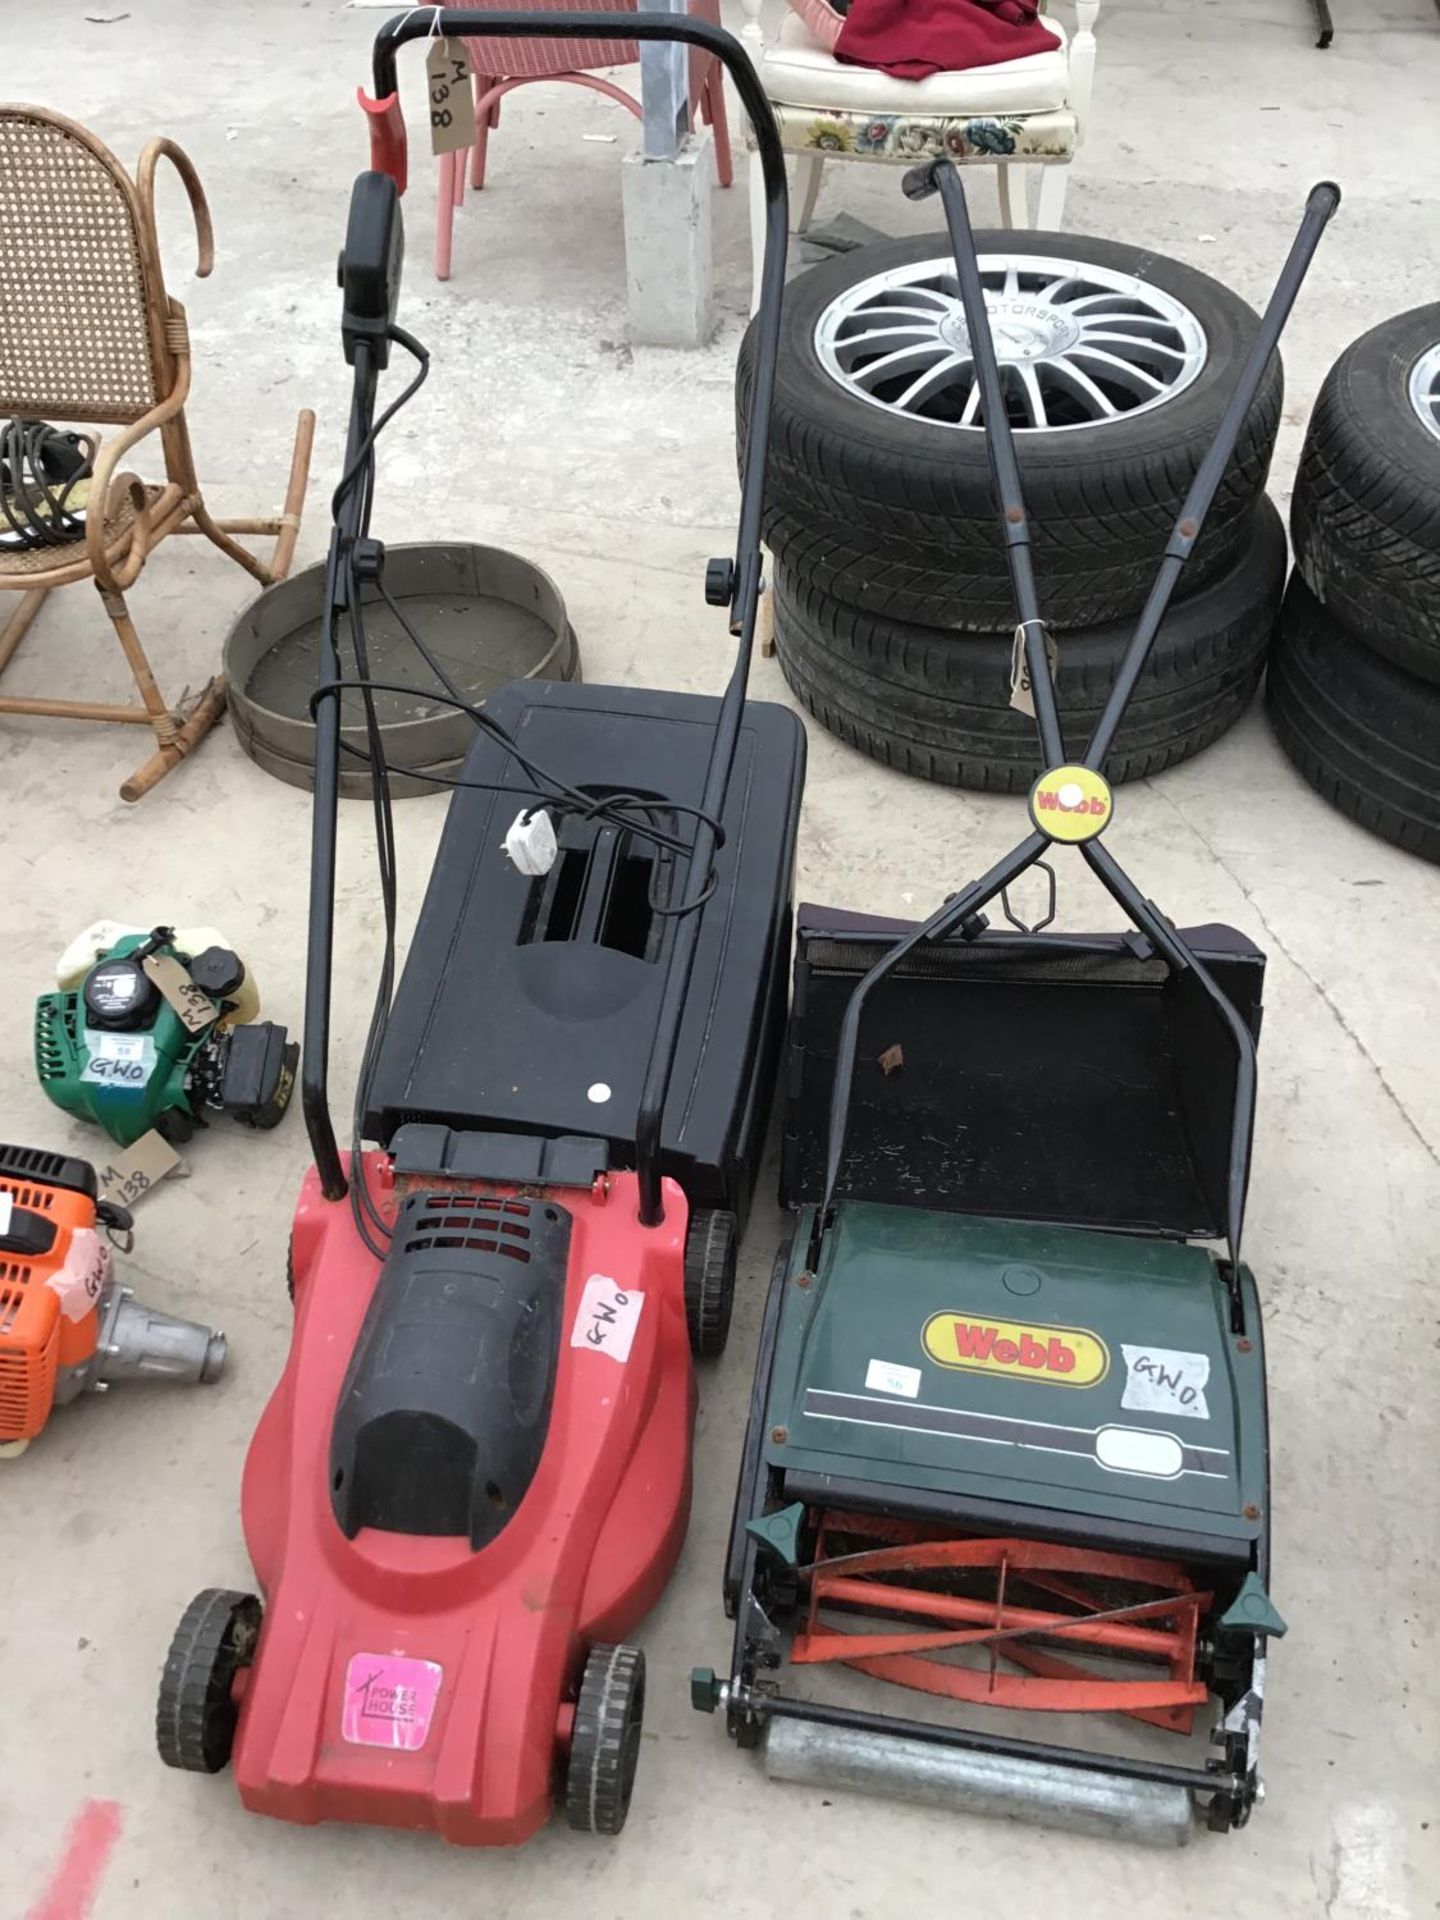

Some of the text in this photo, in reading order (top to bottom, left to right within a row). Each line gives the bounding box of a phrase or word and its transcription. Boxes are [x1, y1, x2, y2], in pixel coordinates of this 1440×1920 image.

[451, 60, 468, 84] M
[431, 73, 453, 128] 138
[179, 984, 212, 1013] 138
[181, 1008, 203, 1026] M
[100, 1165, 125, 1187] M
[116, 1170, 150, 1203] 138
[954, 1323, 1076, 1373] Webb
[371, 1687, 417, 1702] POWER
[368, 1700, 416, 1716] HOUSE
